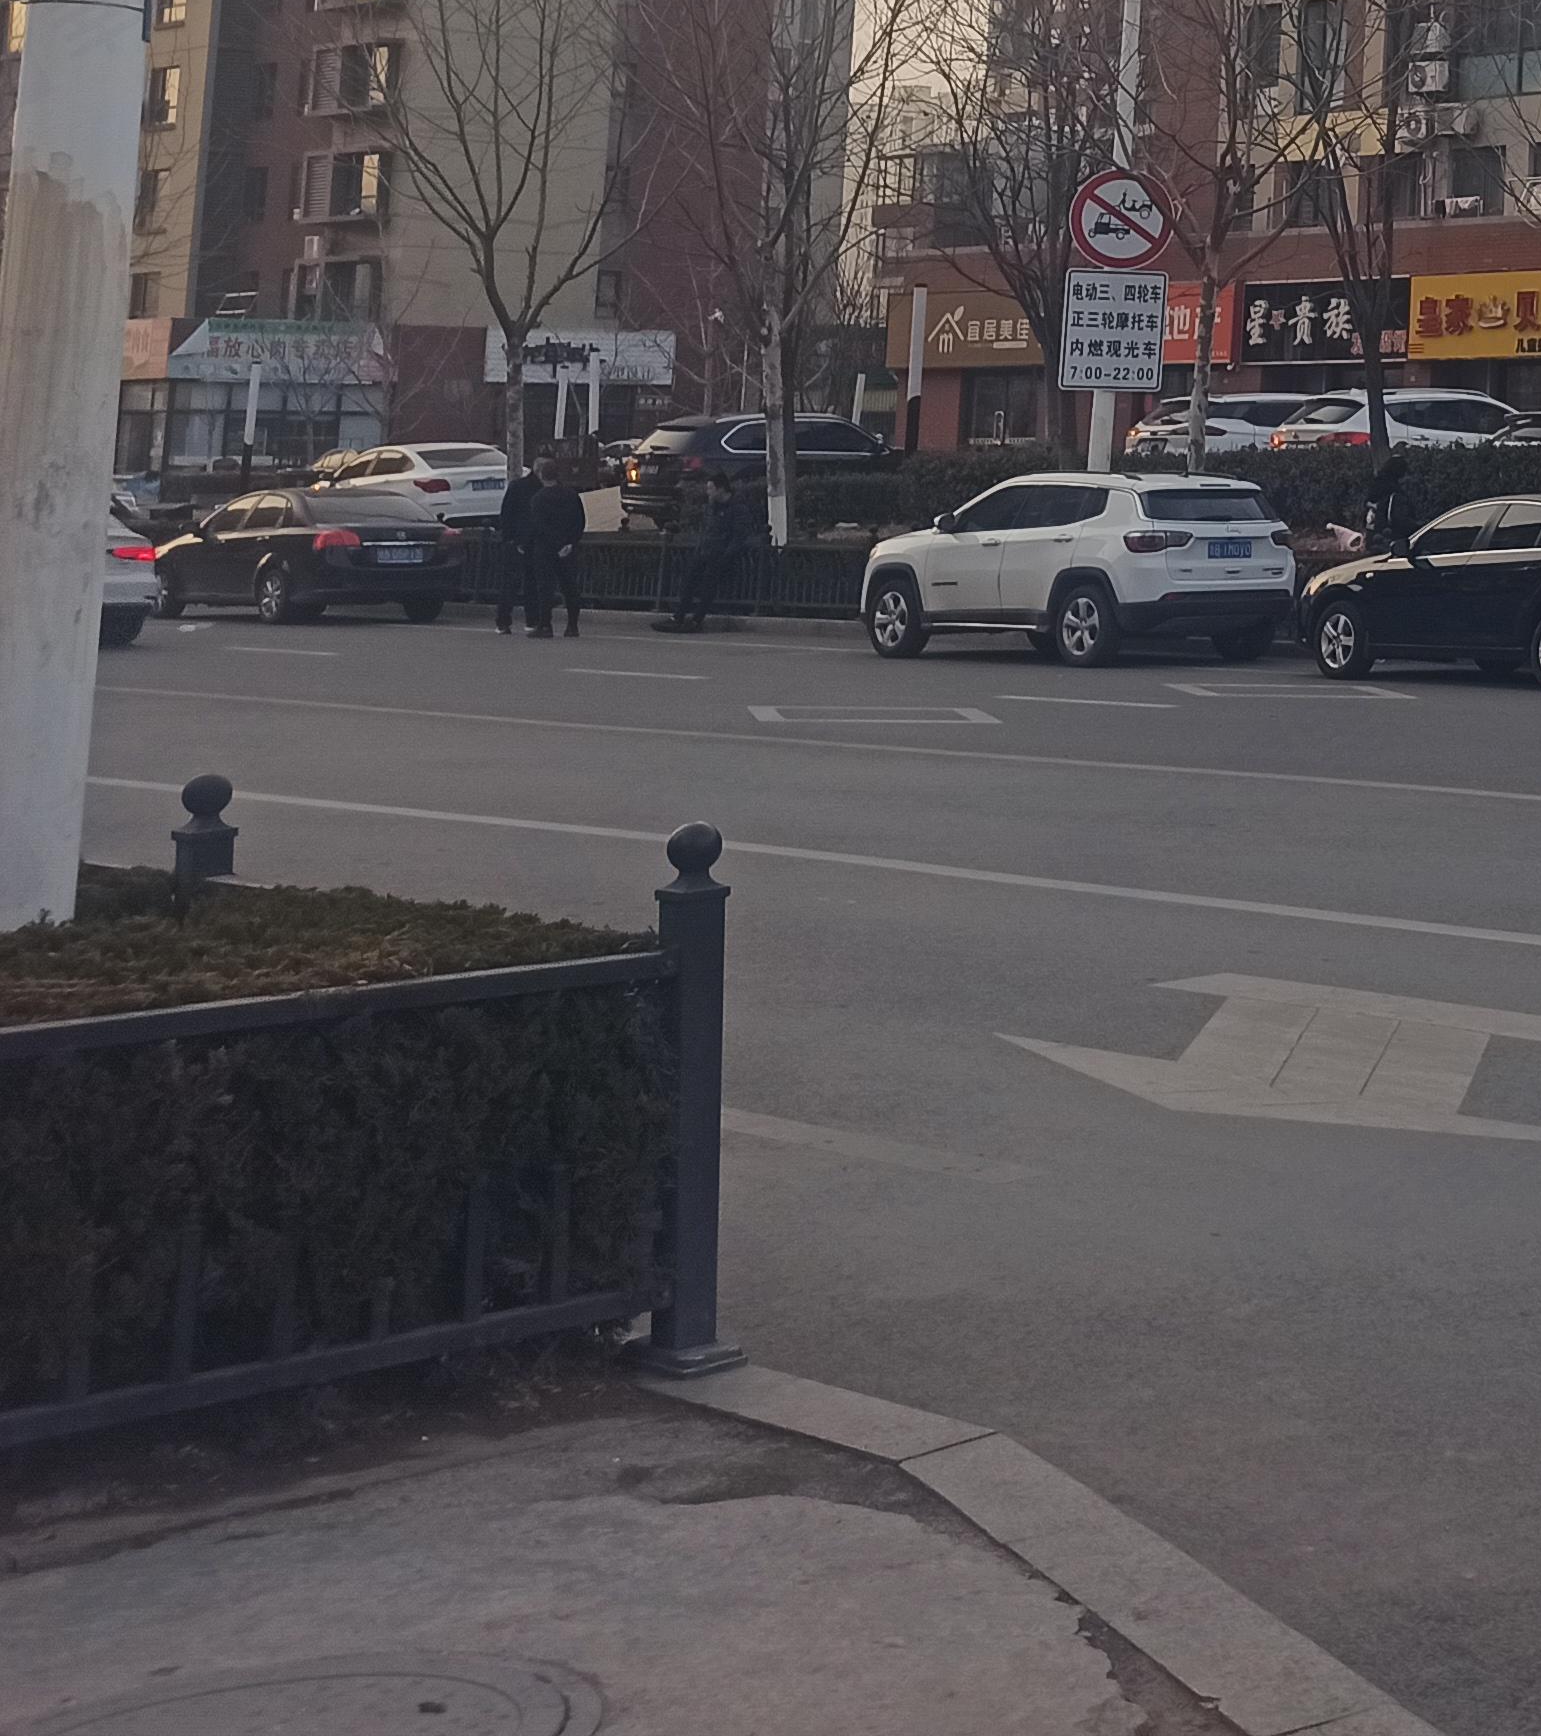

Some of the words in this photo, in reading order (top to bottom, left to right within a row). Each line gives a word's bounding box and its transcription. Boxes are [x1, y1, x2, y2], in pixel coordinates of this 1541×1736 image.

[1072, 281, 1162, 304] 电动三、四轮车
[1070, 311, 1160, 332] 正三轮摩托车
[1070, 338, 1158, 360] 内燃观光车
[1070, 365, 1155, 382] 7:00-22:00
